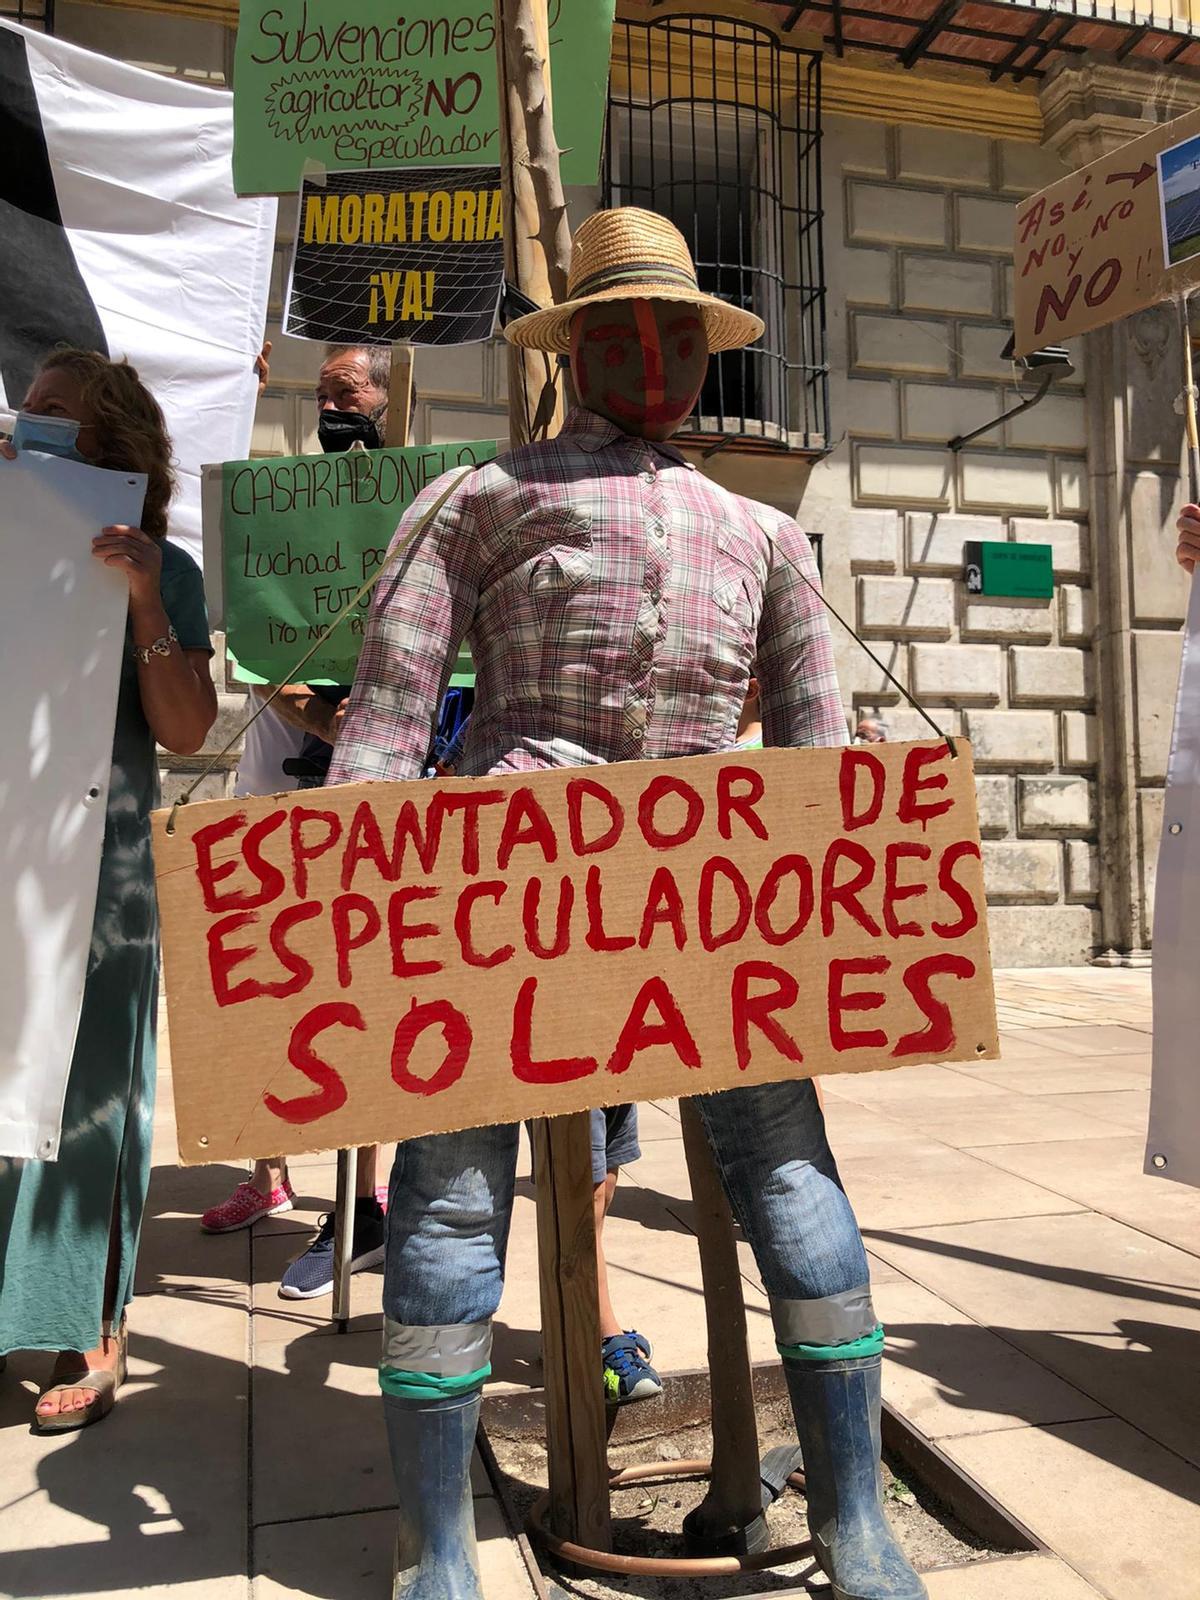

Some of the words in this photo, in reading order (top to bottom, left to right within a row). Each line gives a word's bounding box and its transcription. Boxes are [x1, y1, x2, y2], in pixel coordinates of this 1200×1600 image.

[251, 0, 496, 64] Subvenciones
[280, 78, 410, 131] agricultor
[423, 72, 482, 117] NO
[334, 125, 499, 168] especulador
[303, 189, 501, 245] MORATORIA
[1091, 200, 1134, 239] NO
[368, 271, 435, 323] ¡YA!
[243, 535, 346, 578] Luchad
[192, 766, 768, 913] ESPANTADOR
[839, 744, 955, 839] DE
[207, 841, 981, 1007] ESPECULADORES
[264, 952, 975, 1124] SOLARES
